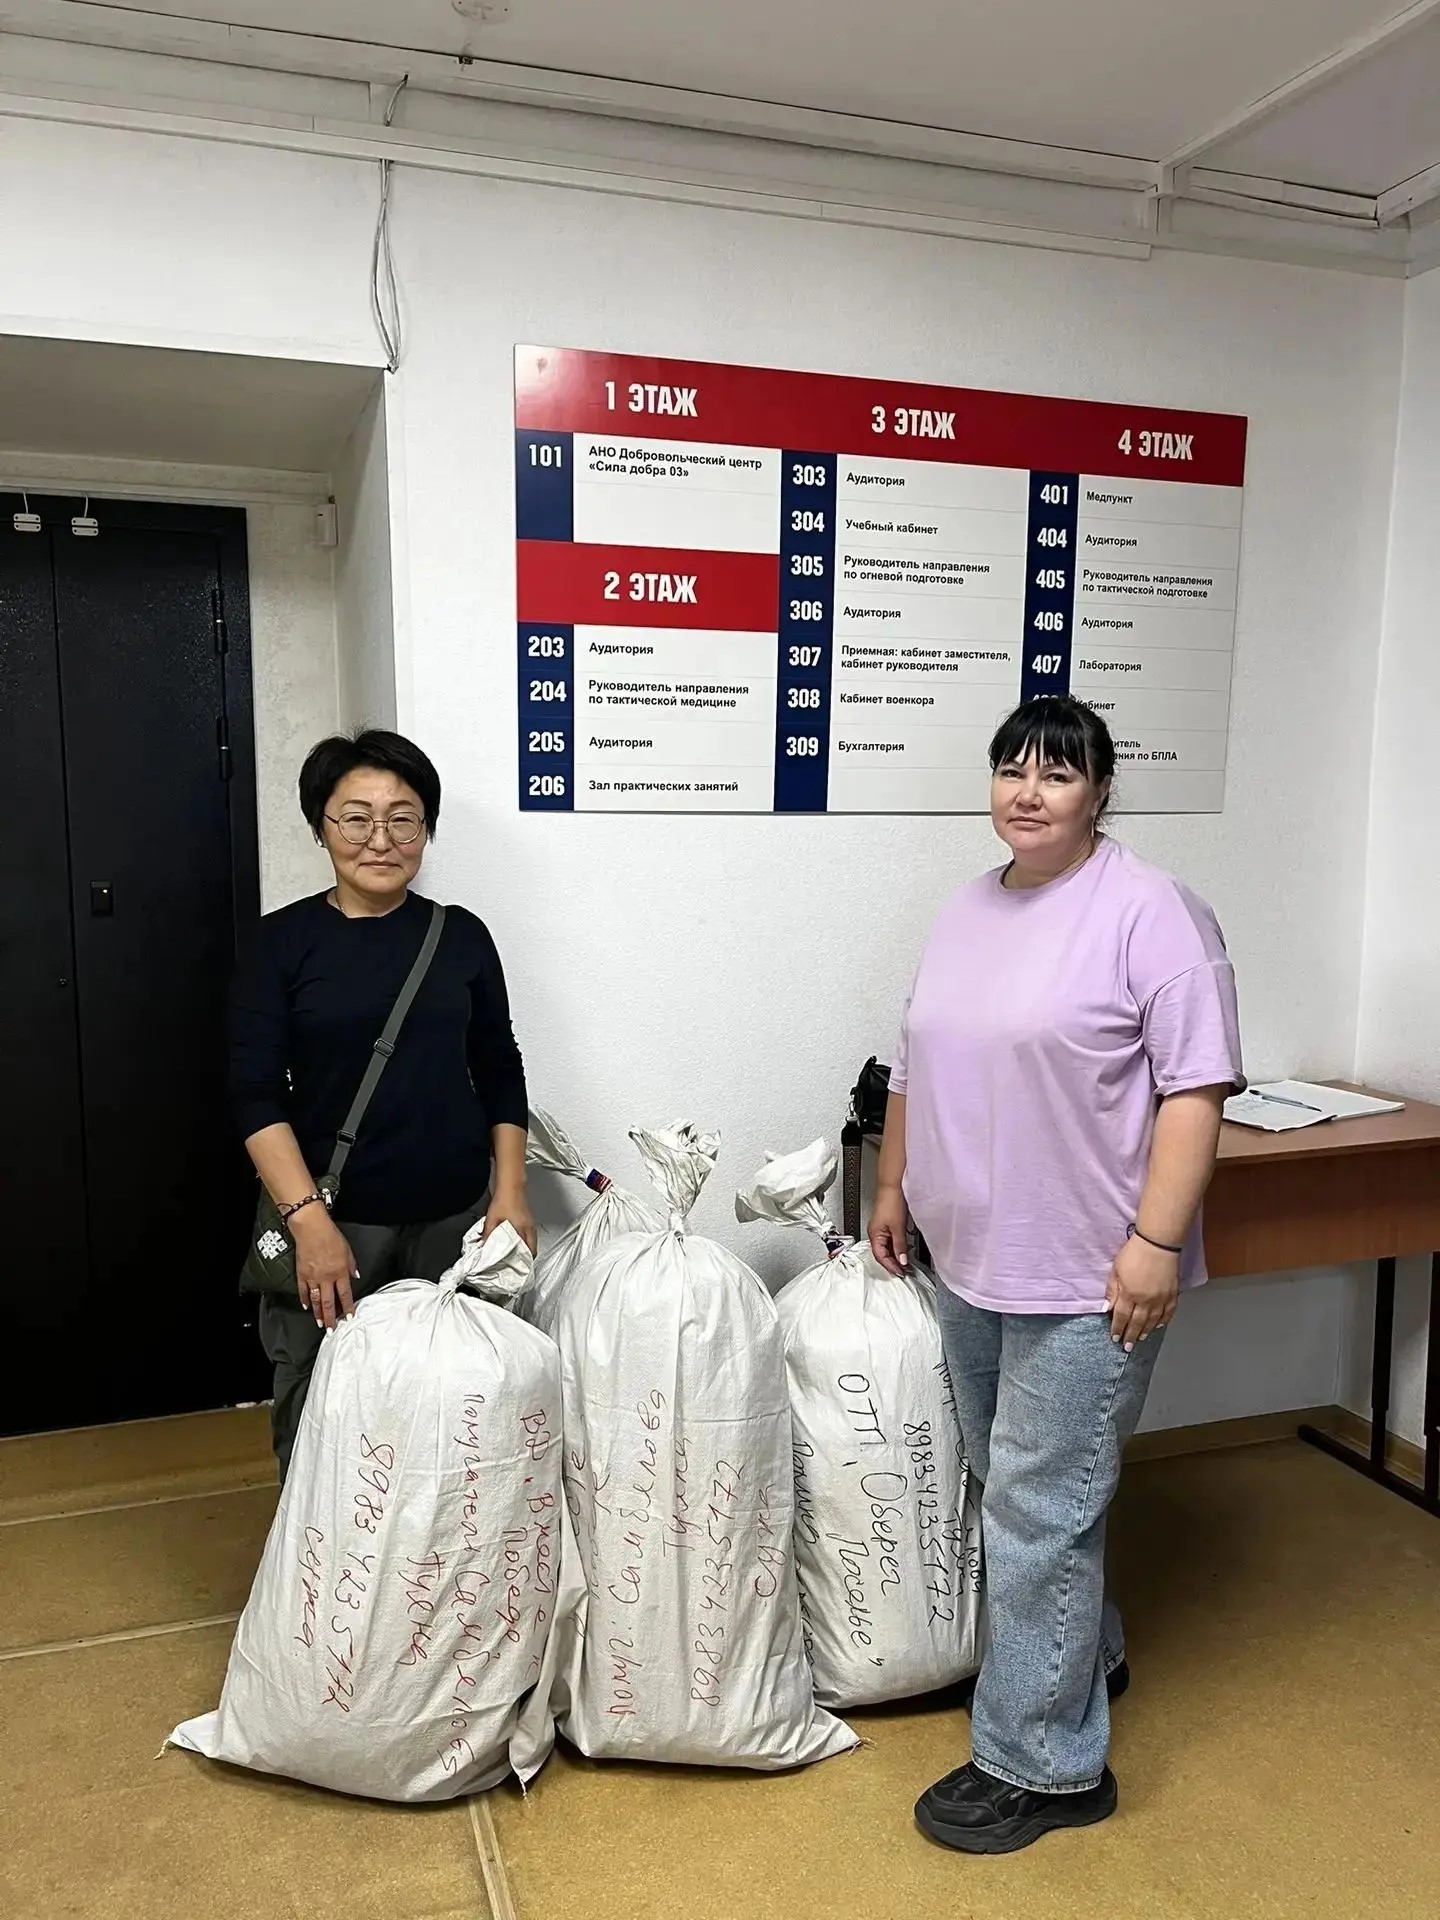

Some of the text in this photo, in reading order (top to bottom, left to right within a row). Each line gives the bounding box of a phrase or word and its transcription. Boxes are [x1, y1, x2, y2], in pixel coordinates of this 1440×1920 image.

[604, 381, 698, 417] 1 ЭТАЖ
[871, 405, 956, 440] 3 ЭТАЖ
[1118, 429, 1194, 461] 4 ЭТАЖ
[528, 444, 563, 468] 101
[589, 446, 763, 470] АНО Добровольческий центр
[589, 461, 689, 477] «Сила добра 03»
[792, 464, 826, 487] 303
[846, 472, 905, 487] Аудитория
[1040, 484, 1069, 505] 401
[1086, 490, 1133, 505] Медпункт
[791, 510, 825, 533] 304
[845, 518, 939, 535] Учебный кабинет
[1037, 527, 1067, 548] 404
[1085, 534, 1138, 547] Аудитория
[790, 555, 824, 577] 305
[844, 555, 990, 574] Руководитель направления
[604, 571, 698, 604] 2 ЭТАЖ
[844, 570, 965, 586] по огневой подготовке
[1035, 569, 1065, 589] 405
[1083, 569, 1213, 587] Руководитель направления
[1082, 583, 1208, 598] по тактической подготовке
[789, 600, 823, 621] 306
[843, 606, 901, 619] Аудитория
[1033, 611, 1064, 631] 406
[1081, 617, 1133, 629] Аудитория
[528, 636, 565, 658] 203
[589, 642, 654, 655] Аудитория
[788, 646, 822, 667] 307
[841, 645, 1011, 662] Приемная: кабинет заместителя,
[841, 659, 959, 673] кабинет руководителя
[1031, 654, 1062, 674] 407
[1079, 660, 1142, 673] Лаборатория
[529, 680, 567, 702] 204
[588, 680, 749, 696] Руководитель направления
[588, 694, 737, 708] по тактической медицине
[787, 688, 821, 709] 308
[840, 693, 935, 706] Кабинет военкора
[528, 731, 565, 752] 205
[589, 736, 653, 749] Аудитория
[786, 736, 819, 757] 309
[838, 740, 905, 753] Бухгалтерия
[1137, 752, 1149, 761] по
[1151, 751, 1178, 762] БПЛА
[528, 775, 565, 796] 206
[588, 780, 739, 793] Зал практических занятий
